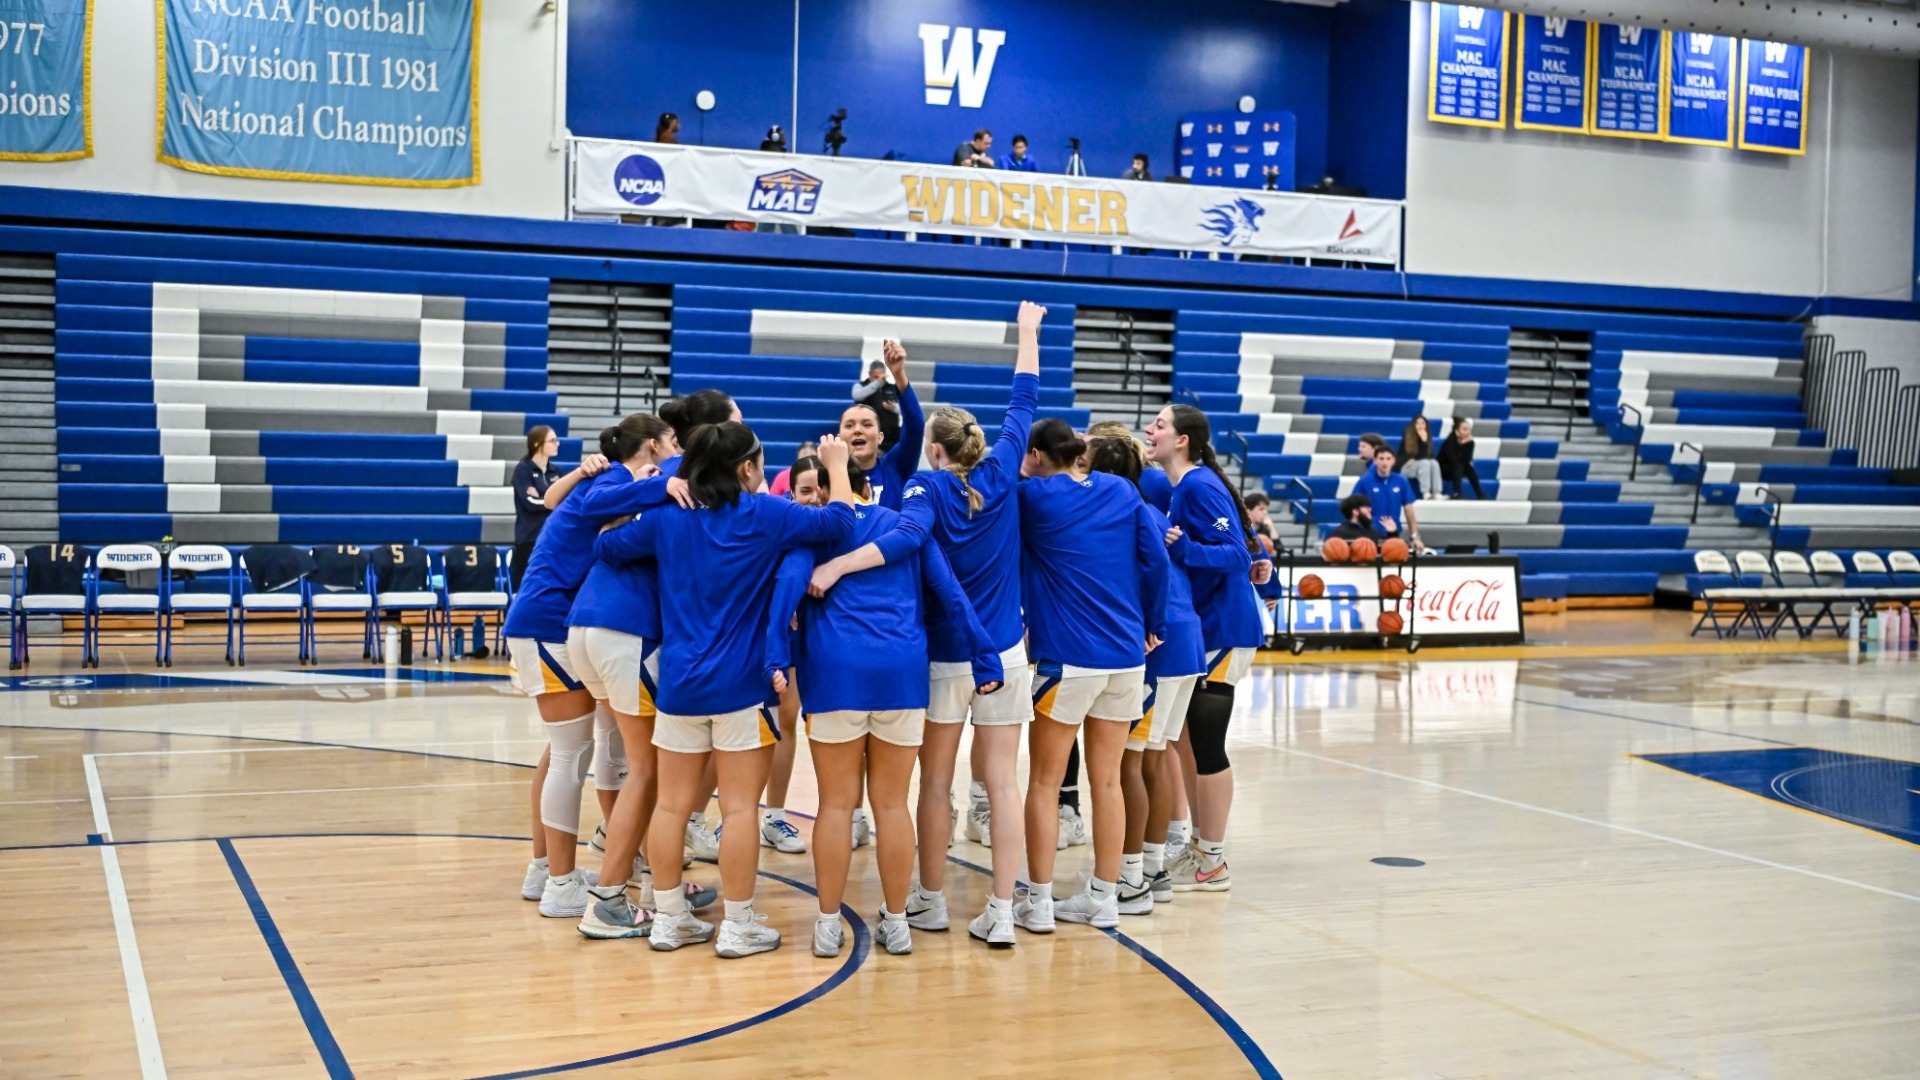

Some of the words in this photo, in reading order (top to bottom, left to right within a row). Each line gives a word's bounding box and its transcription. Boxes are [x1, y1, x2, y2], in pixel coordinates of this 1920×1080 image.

[192, 0, 295, 23] NCAA
[305, 0, 426, 36] Football
[193, 39, 318, 83] Division
[327, 51, 372, 87] III
[381, 57, 440, 92] 1981
[1456, 49, 1483, 65] MAC
[1542, 58, 1567, 73] MAC
[918, 23, 1006, 109] W
[1441, 62, 1497, 80] CHAMPIONS
[1614, 66, 1644, 81] NCAA
[1527, 70, 1580, 87] CHAMPIONS
[1601, 78, 1657, 92] TOURNAMENT
[1686, 74, 1715, 89] NCAA
[1673, 85, 1727, 101] TOURNAMENT
[1749, 84, 1775, 98] FINAL
[181, 93, 305, 138] National
[313, 106, 467, 155] Champions
[619, 178, 664, 194] NCAA
[751, 190, 815, 212] MAC
[901, 175, 1129, 236] WIDENER
[51, 544, 74, 561] 14
[106, 553, 153, 562] WIDENER
[178, 554, 224, 563] WIDENER
[391, 544, 404, 564] 5
[465, 546, 478, 566] 3
